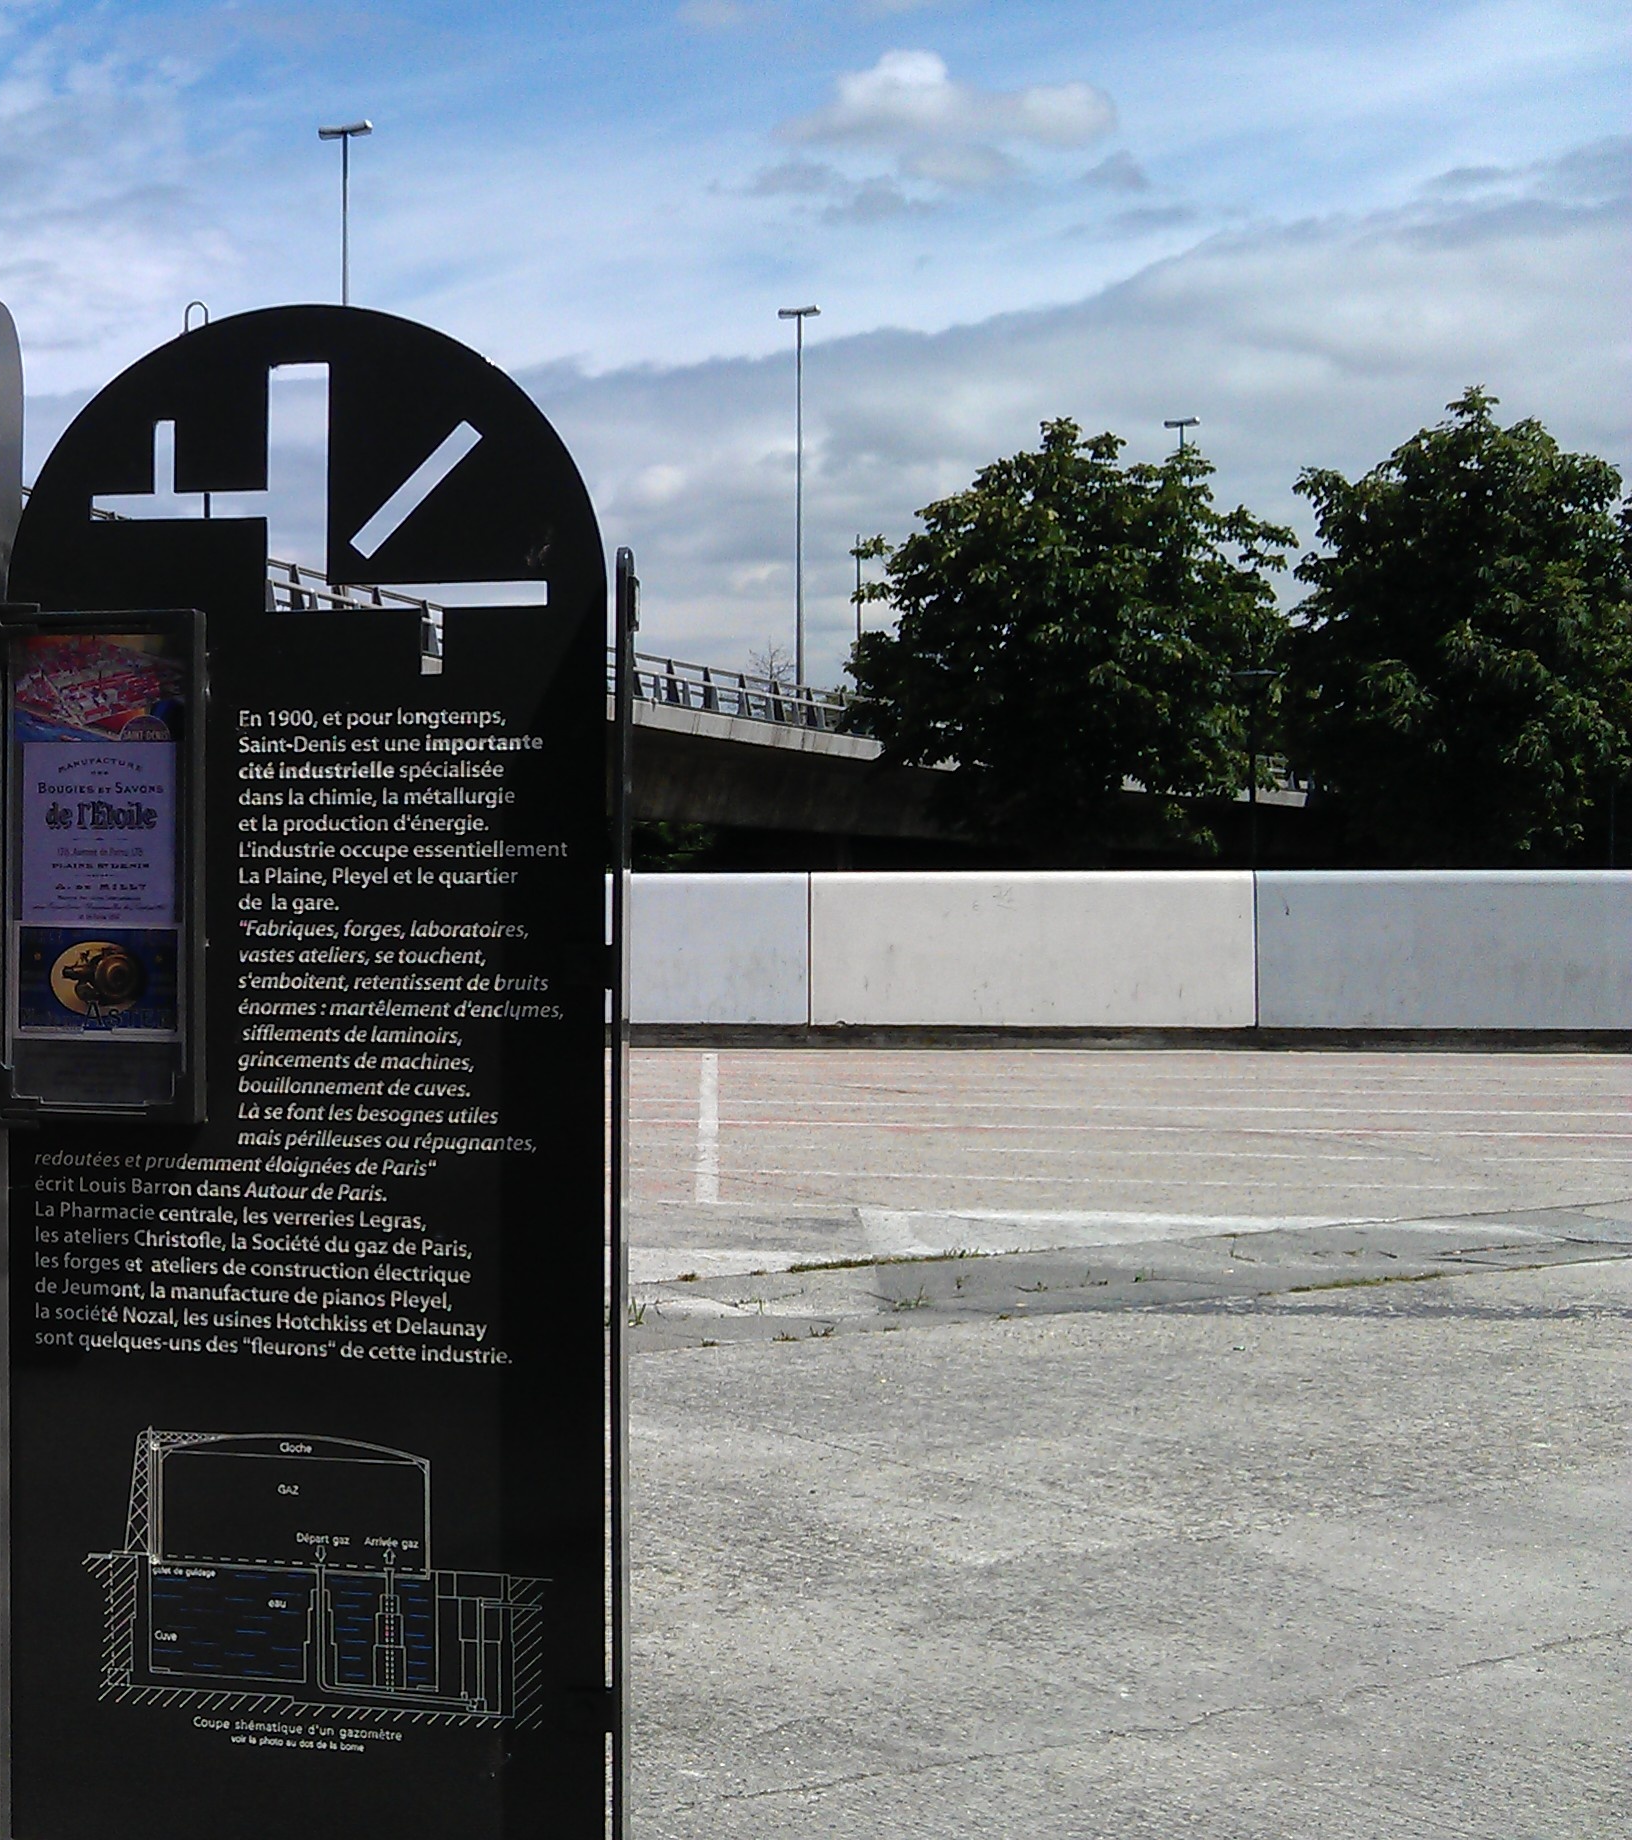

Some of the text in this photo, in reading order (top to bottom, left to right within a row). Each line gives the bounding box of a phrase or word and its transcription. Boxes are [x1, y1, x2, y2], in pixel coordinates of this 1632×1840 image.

[238, 707, 506, 730] En 1900, et pour longtemps,
[239, 734, 543, 755] Saint-Denis est une importante
[57, 757, 144, 773] MANUFACTURE
[239, 760, 504, 782] cité industrielle spécialisée
[37, 782, 95, 794] BOUGIES
[114, 782, 164, 794] SAVONS
[239, 787, 515, 808] dans la chimie, la métallurgie
[45, 801, 73, 830] de
[238, 814, 489, 835] et la production d'énergie.
[239, 840, 568, 862] L'industrie occupe essentiellement
[239, 867, 518, 888] La Plaine, Pleyel et le quartier
[238, 893, 339, 914] de la gare.
[344, 919, 405, 941] forges,
[410, 920, 528, 939] laboratoires,
[239, 946, 486, 966] vastes ateliers, se touchent,
[238, 972, 548, 992] s'emboitent, retentissent de bruits
[238, 998, 317, 1015] énormes
[243, 1024, 462, 1046] sifflements de laminoirs,
[238, 1050, 474, 1072] grincements de machines,
[238, 1076, 470, 1097] bouillonnement de cuves.
[238, 1102, 498, 1126] Là se font les besognes utiles
[237, 1129, 538, 1155] mais périlleuses ou répugnantes,
[34, 1150, 436, 1177] redoutées et prudemment éloignées de Paris"
[35, 1175, 387, 1201] écrit Louis Barron dans Autour de Paris.
[35, 1201, 426, 1232] La Pharmacie centrale, les verreries Legras,
[36, 1226, 472, 1259] les ateliers Christofle, la Société du gaz de Paris,
[35, 1251, 471, 1287] les forges et ateliers de construction électrique
[35, 1277, 452, 1313] de Jeumont, la manufacture de pianos Pleyel,
[36, 1302, 487, 1341] la société Nozal, les usines Hotchkiss et Delaunay
[35, 1331, 512, 1364] sont quelques-uns des "fleurons" de cette industrie.
[279, 1442, 313, 1454] Cloche
[277, 1484, 300, 1496] GAZ
[296, 1532, 350, 1547] Départ gaz
[364, 1536, 419, 1551] Arrivée gaz
[173, 1567, 183, 1575] de
[185, 1567, 216, 1579] guidage
[267, 1599, 287, 1609] eau
[154, 1630, 178, 1641] Cuve
[193, 1715, 403, 1741] Coupe shématique d'un gazomètre
[230, 1734, 247, 1743] voir
[259, 1737, 284, 1747] photo
[286, 1739, 297, 1747] au
[299, 1739, 314, 1748] dos
[316, 1741, 328, 1750] de
